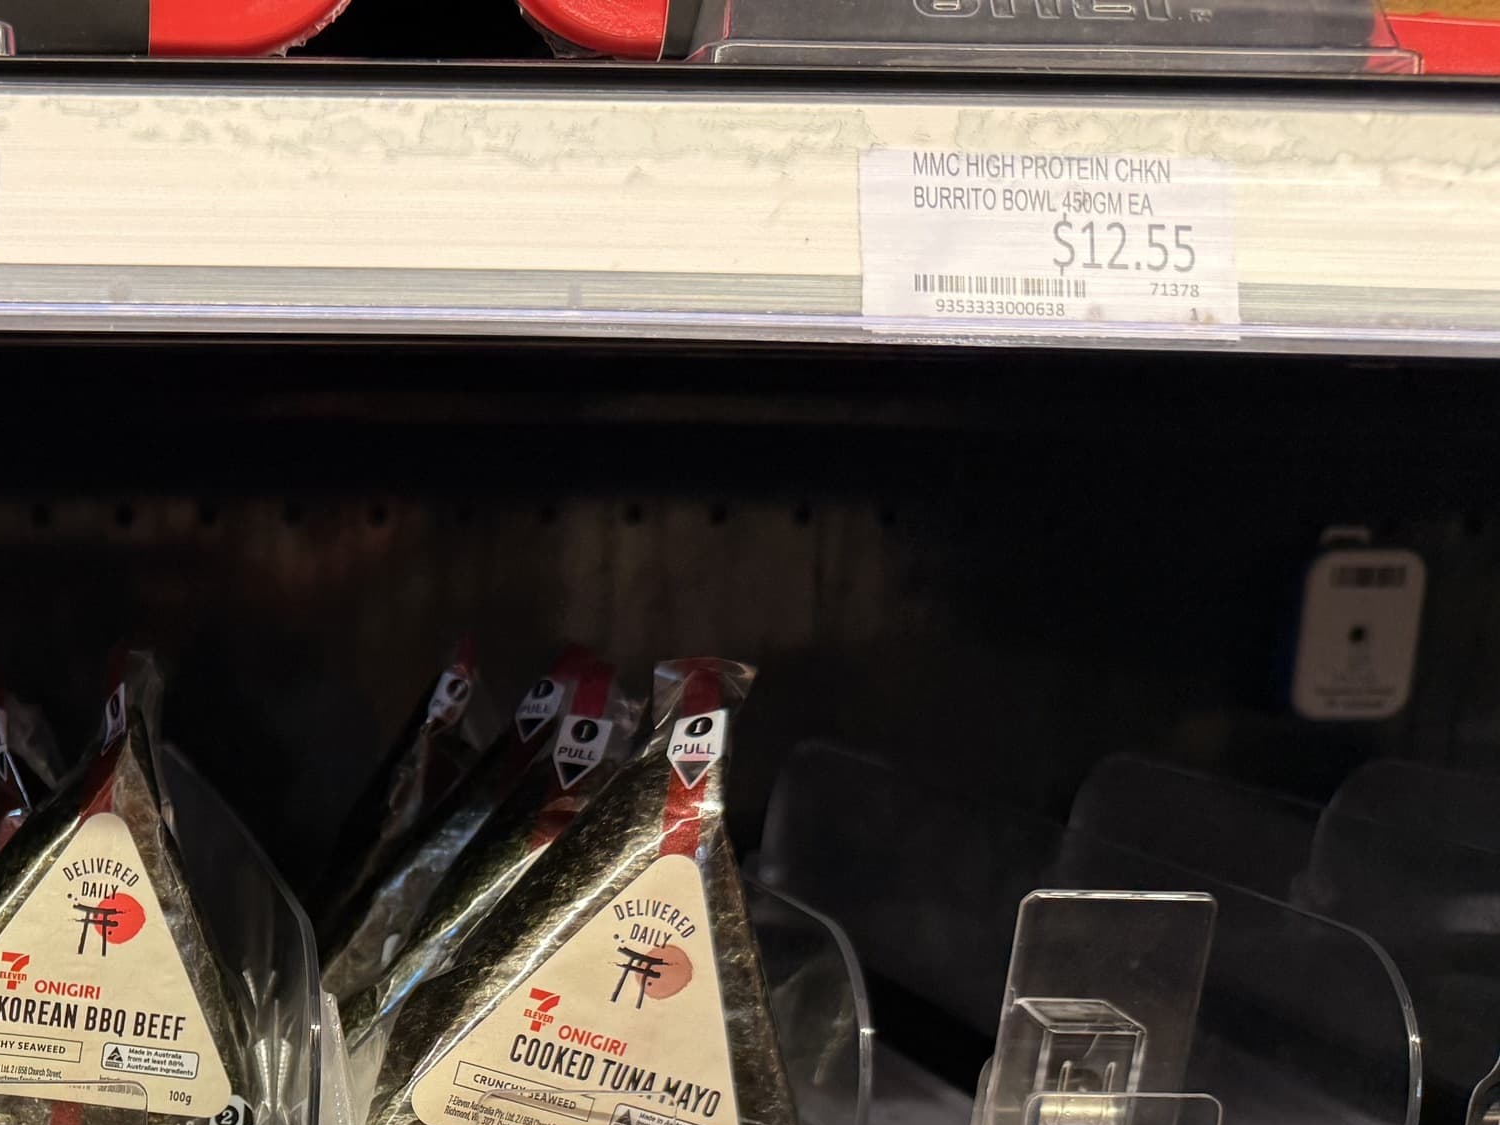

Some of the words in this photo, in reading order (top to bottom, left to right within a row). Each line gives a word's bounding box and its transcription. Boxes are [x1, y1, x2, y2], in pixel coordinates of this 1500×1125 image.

[912, 152, 960, 177] MMC
[966, 155, 1015, 179] HIGH
[1022, 156, 1108, 181] PROTEIN
[1115, 159, 1171, 184] CHKN
[914, 186, 997, 210] BURRITO
[1002, 189, 1056, 213] BOWL
[1062, 191, 1123, 215] 450GM
[1128, 193, 1153, 216] EA
[1052, 212, 1196, 275] $12.55
[1149, 282, 1200, 298] 71378
[935, 299, 1065, 317] 9353333000638
[556, 746, 596, 761] PULL
[672, 743, 717, 756] PULL
[62, 857, 140, 888] DELIVERED
[81, 881, 119, 900] DAILY
[613, 899, 696, 939] DELIVERED
[629, 923, 672, 949] DAILY
[0, 971, 28, 981] ELEVEN
[34, 979, 101, 1000] ONIGIRI
[84, 1006, 126, 1038] BBQ
[132, 1011, 186, 1042] BEEF
[523, 1009, 555, 1025] ELEVEN
[17, 1042, 66, 1055] SEAWEED
[557, 1025, 628, 1057] ONIGIRI
[509, 1033, 595, 1082] COOKED
[599, 1058, 657, 1099] TUNA
[657, 1076, 722, 1118] MAYO
[169, 1090, 192, 1105] 100g
